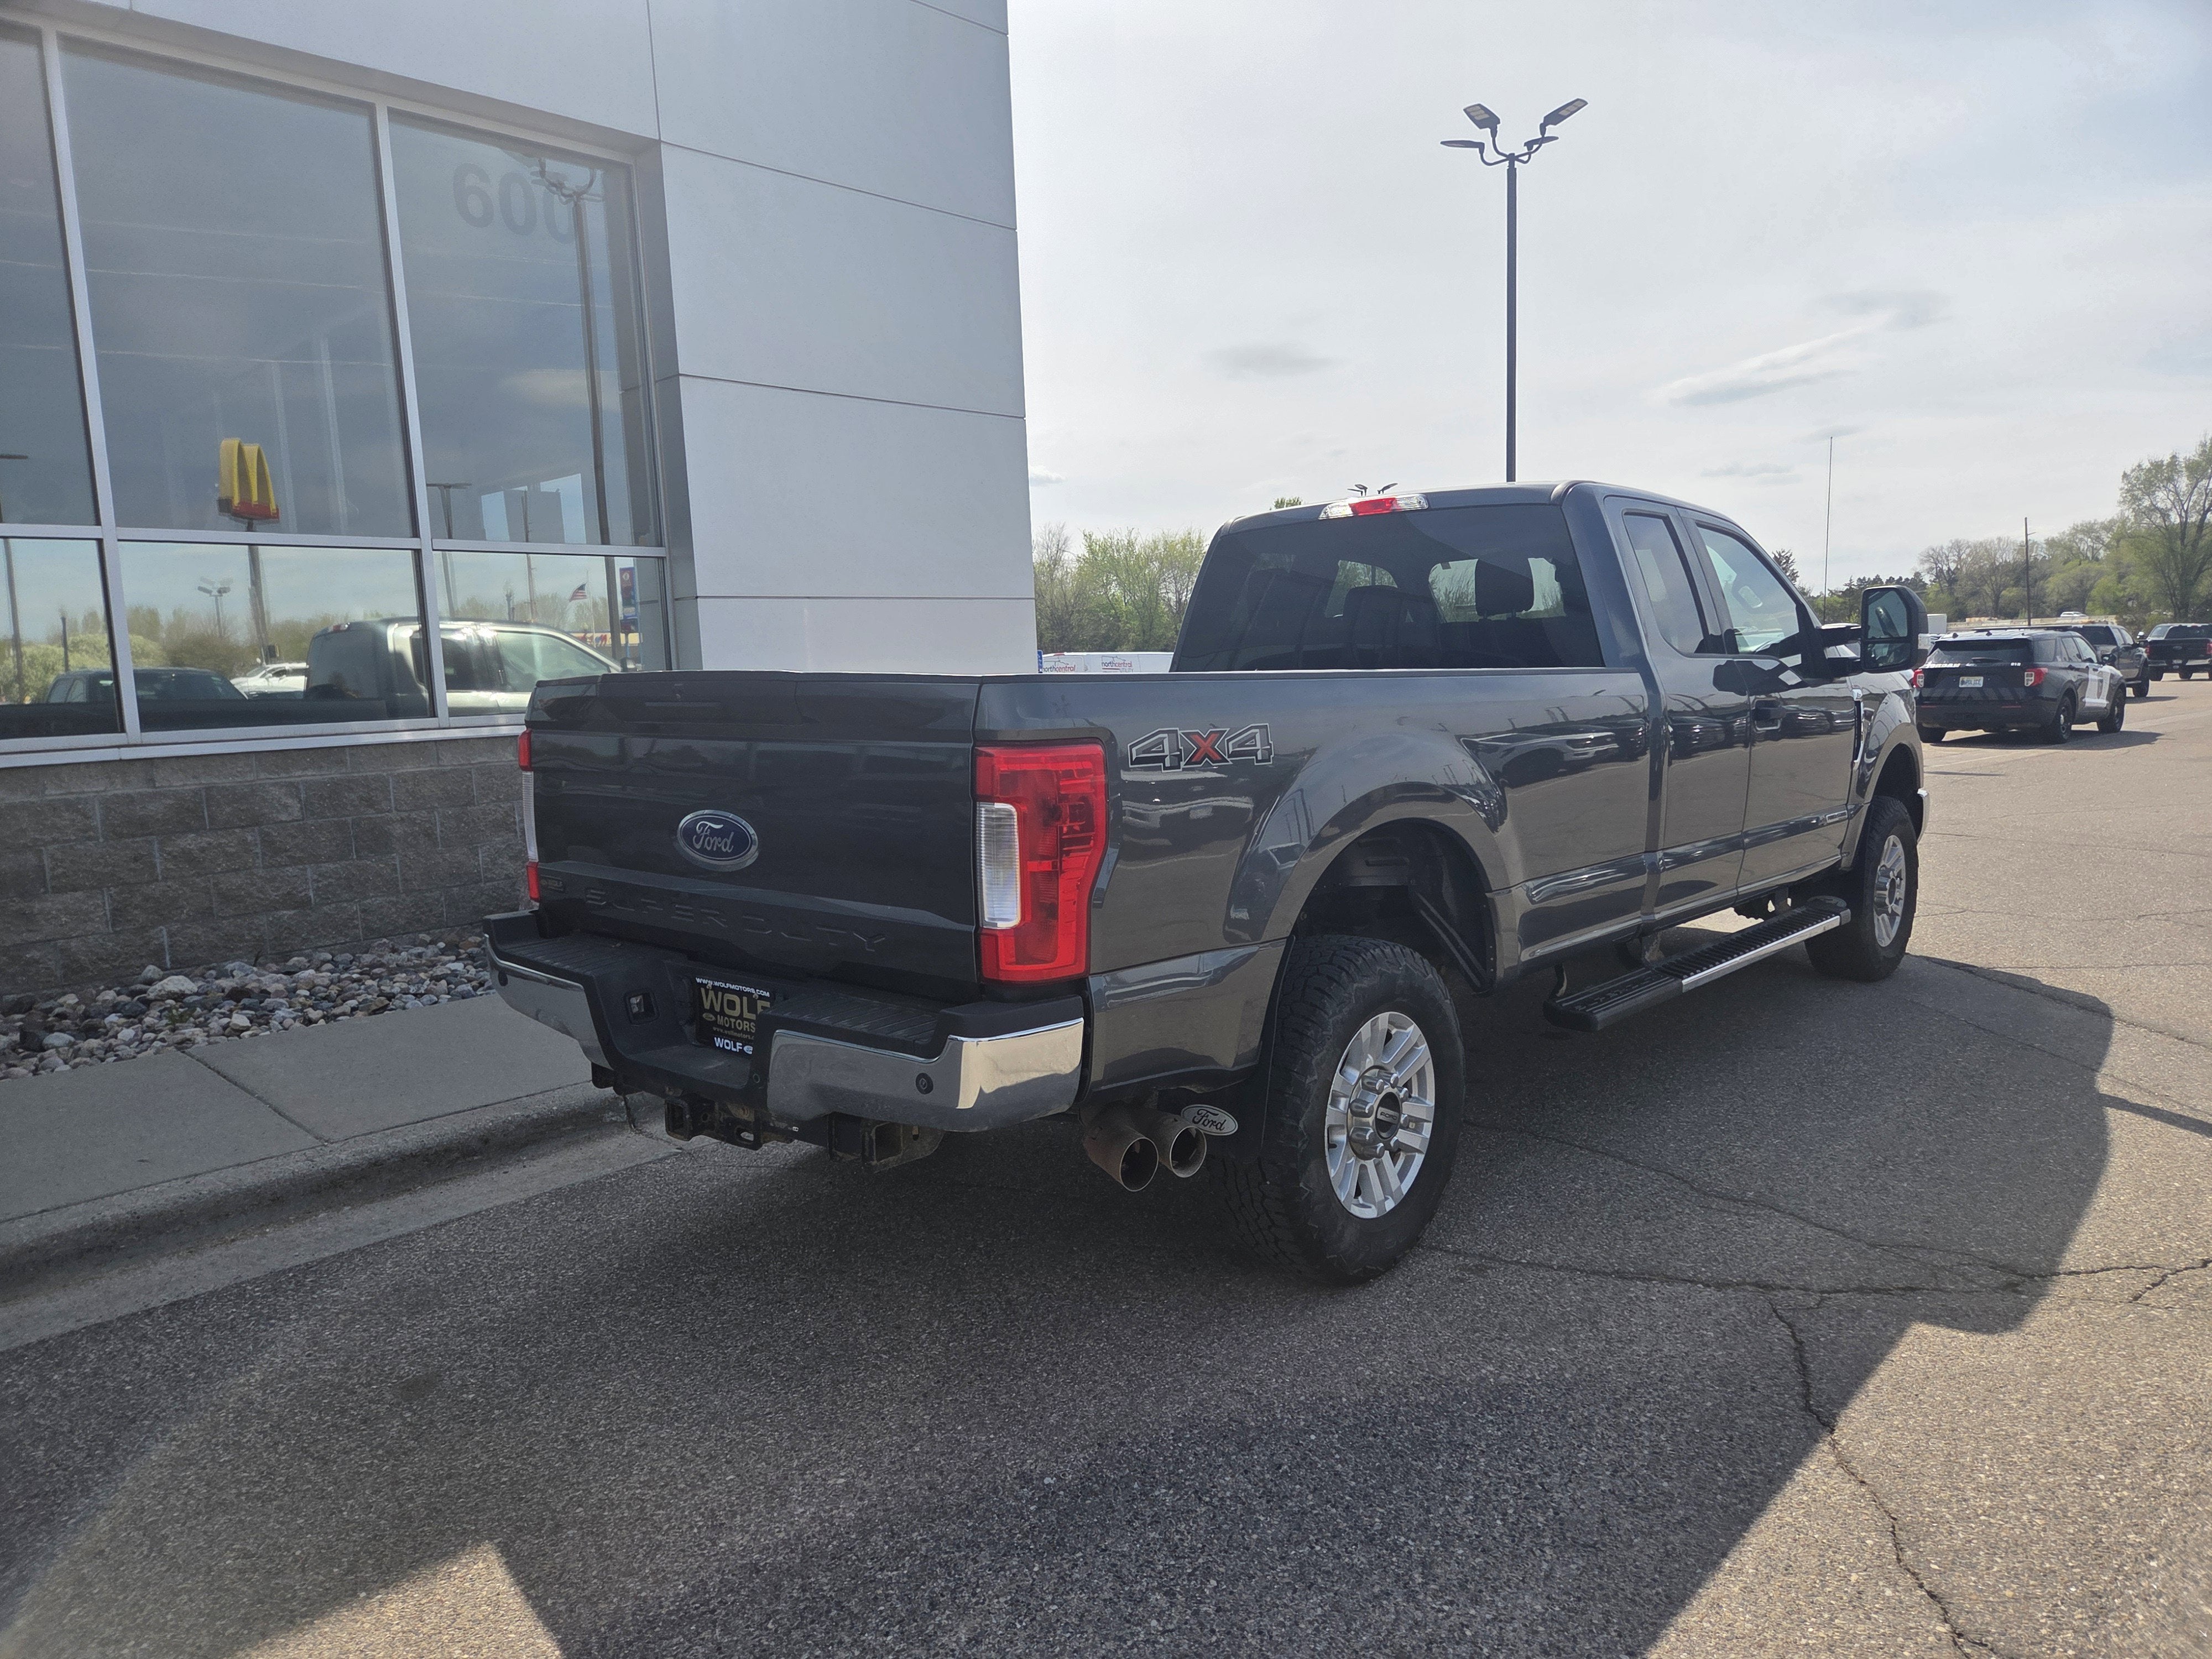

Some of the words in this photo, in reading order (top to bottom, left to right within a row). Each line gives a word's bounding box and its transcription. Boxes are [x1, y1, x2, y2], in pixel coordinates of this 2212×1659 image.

[453, 163, 573, 244] 600
[692, 821, 734, 853] Ford
[586, 888, 728, 929] SUPER
[743, 914, 888, 953] DUTY
[695, 977, 770, 997] WWW.WOLFMOTORS.COM
[700, 987, 771, 1020] WOLF
[717, 1014, 757, 1033] MOTORS
[714, 1037, 743, 1052] WOLF
[1192, 1108, 1227, 1131] Ford
[1380, 1111, 1398, 1120] FORD
